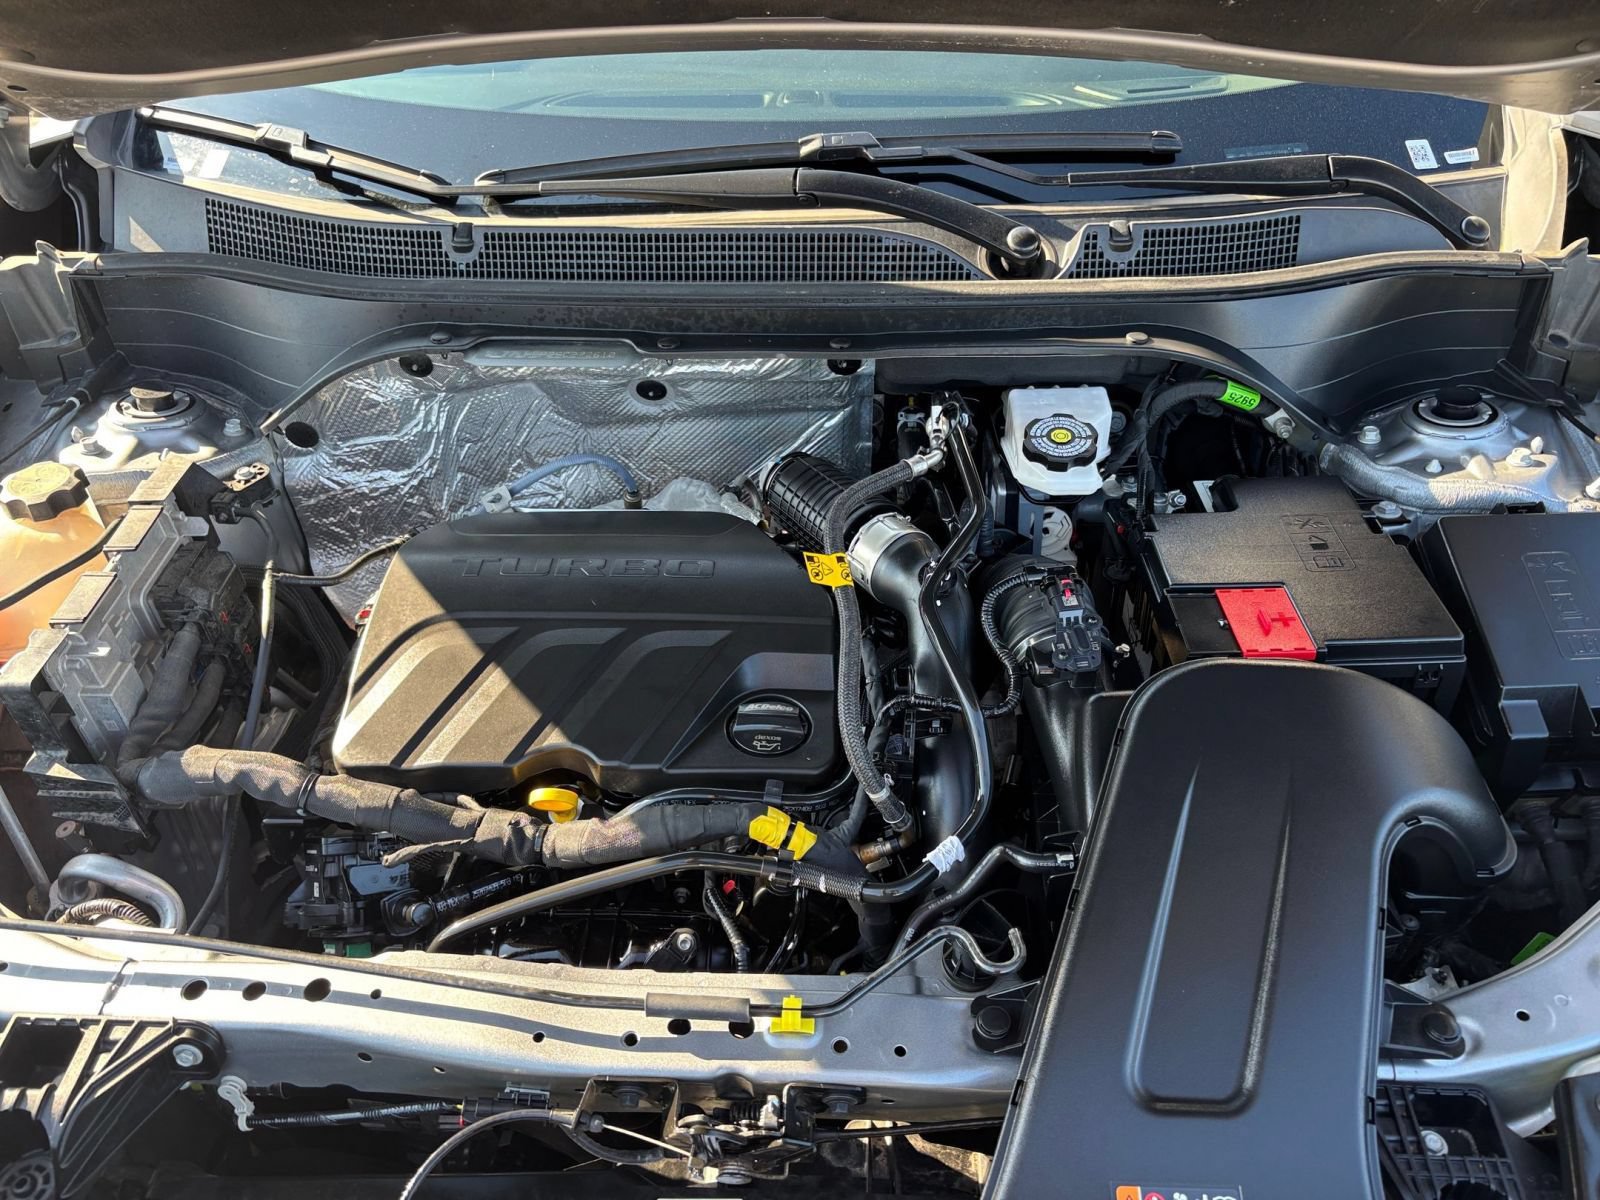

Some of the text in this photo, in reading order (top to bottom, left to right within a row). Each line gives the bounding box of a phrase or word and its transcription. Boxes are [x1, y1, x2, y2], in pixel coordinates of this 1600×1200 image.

[1227, 392, 1256, 408] 5925
[451, 557, 716, 577] TURBO
[744, 703, 794, 712] ACDelco
